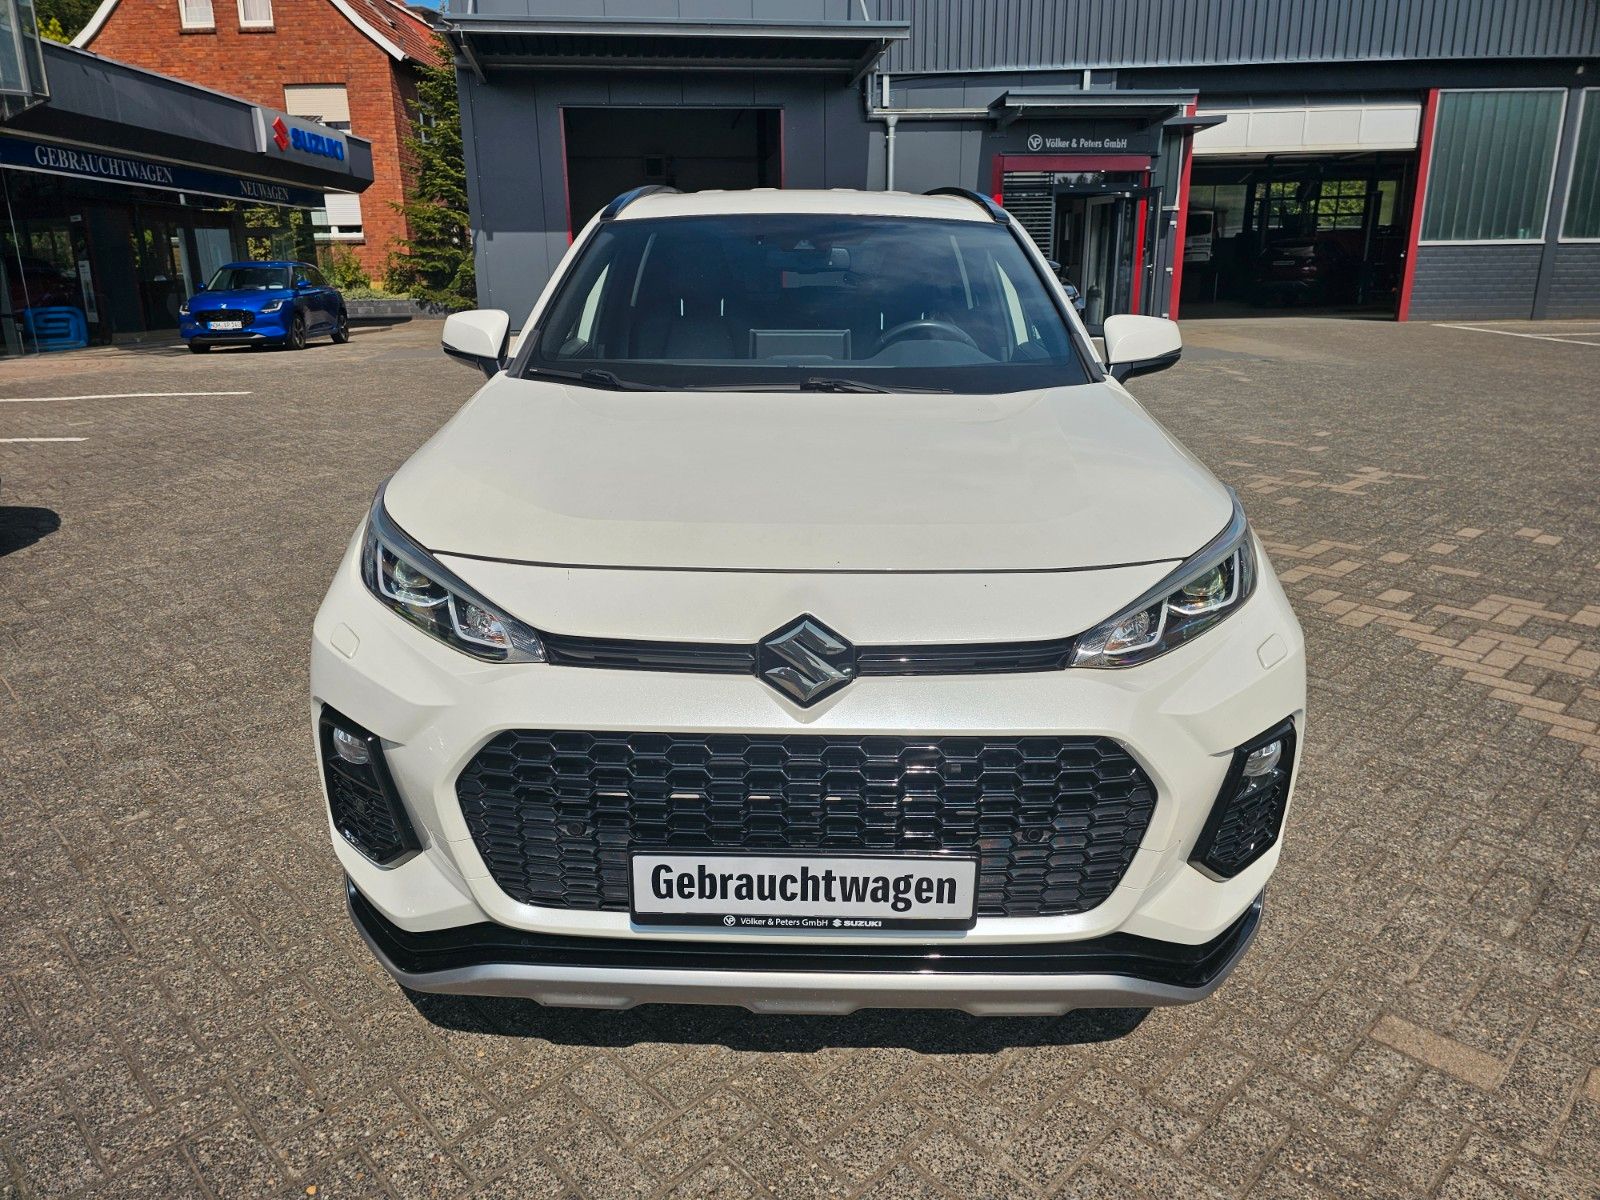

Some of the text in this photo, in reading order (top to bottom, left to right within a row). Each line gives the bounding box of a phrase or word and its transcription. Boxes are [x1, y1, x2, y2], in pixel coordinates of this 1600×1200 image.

[290, 127, 345, 161] SUZUKI
[1045, 138, 1069, 148] Völker
[1071, 138, 1077, 148] &
[1080, 138, 1102, 148] Peters
[1104, 139, 1127, 149] GmbH
[34, 145, 174, 183] GEBRAUCHTWAGEN
[240, 180, 289, 201] NEUWAGEN
[651, 864, 956, 912] Gebrauchtwagen
[740, 917, 766, 926] Völker
[767, 918, 774, 926] &
[775, 918, 800, 926] Peters
[802, 919, 828, 927] GmbH
